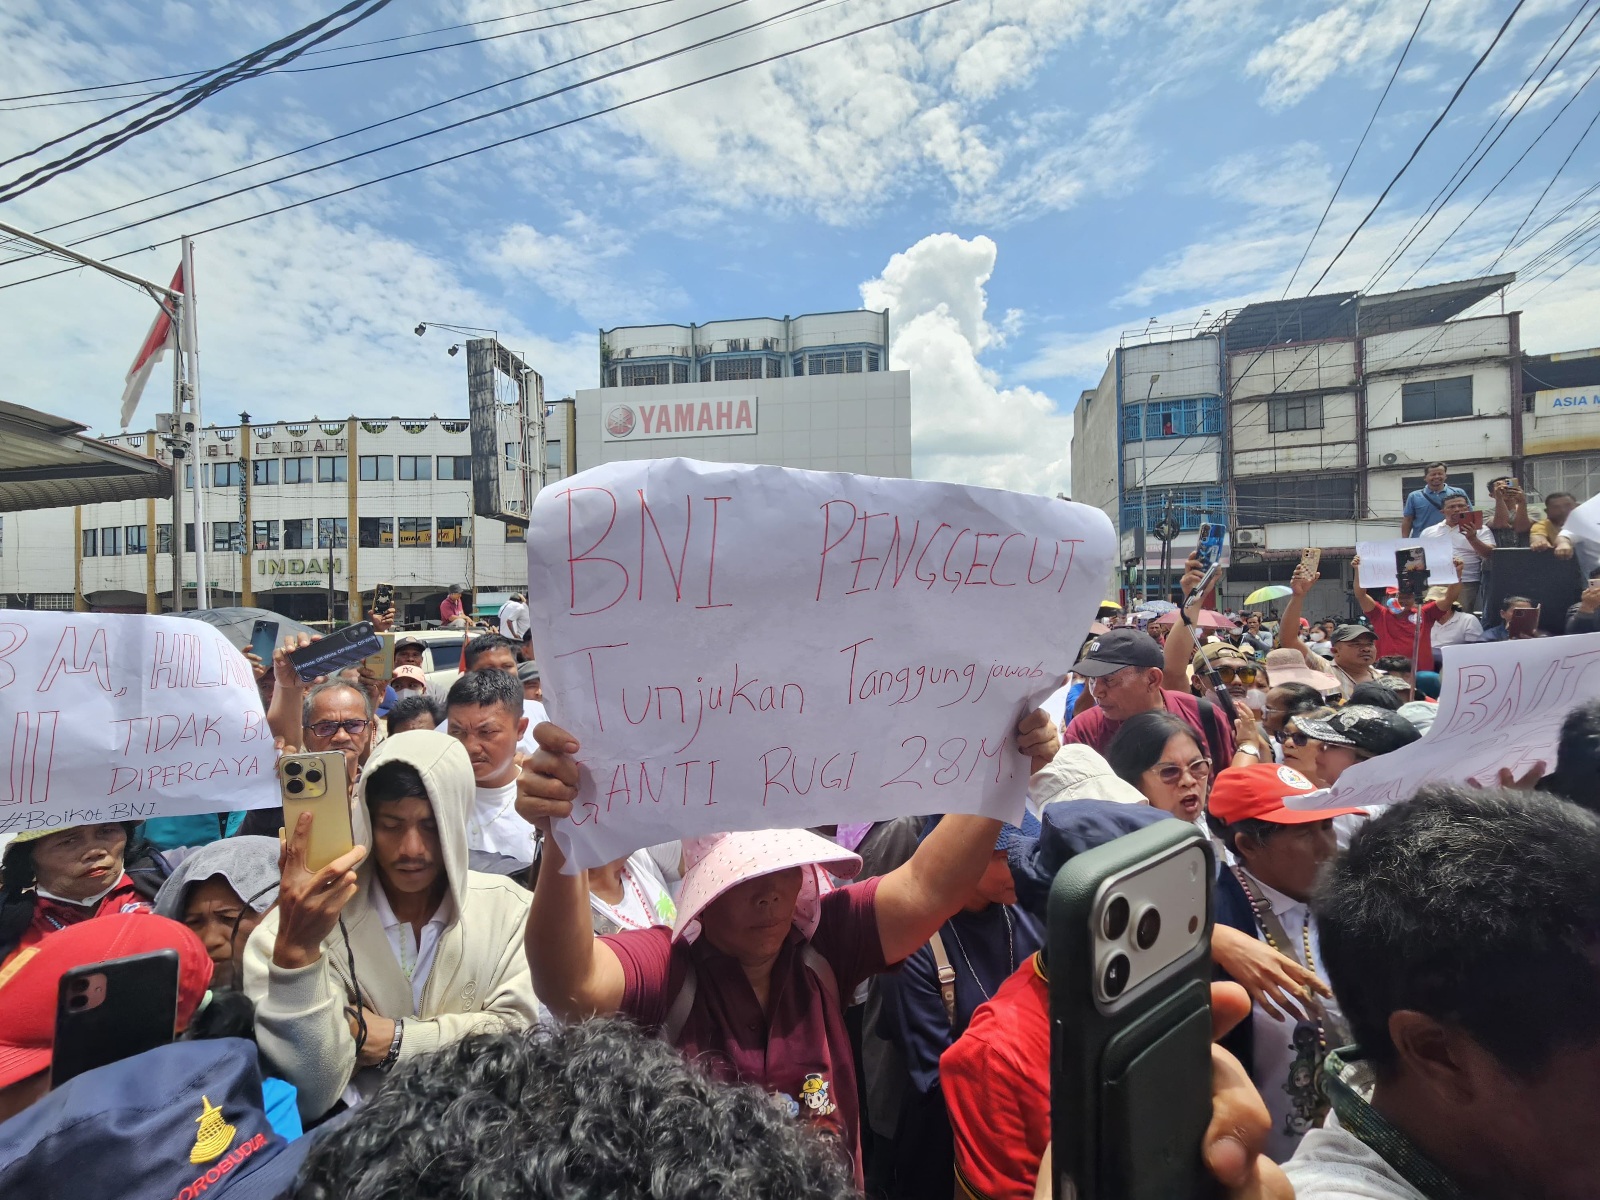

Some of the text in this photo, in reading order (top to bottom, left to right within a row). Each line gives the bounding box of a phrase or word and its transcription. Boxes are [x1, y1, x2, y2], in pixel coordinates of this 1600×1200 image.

[639, 400, 752, 434] YAMAHA
[1552, 395, 1588, 408] ASIA
[156, 438, 345, 460] HEL INDAH
[257, 557, 342, 576] INDAH
[555, 487, 1085, 616] BNI PENGGECUT
[555, 638, 1044, 754] Tunjukan Tanggung jawab
[109, 712, 222, 756] TIDAK
[107, 755, 258, 796] DIPERCAYA
[759, 745, 858, 806] RUGI
[172, 1132, 268, 1200] OROBUDUR
